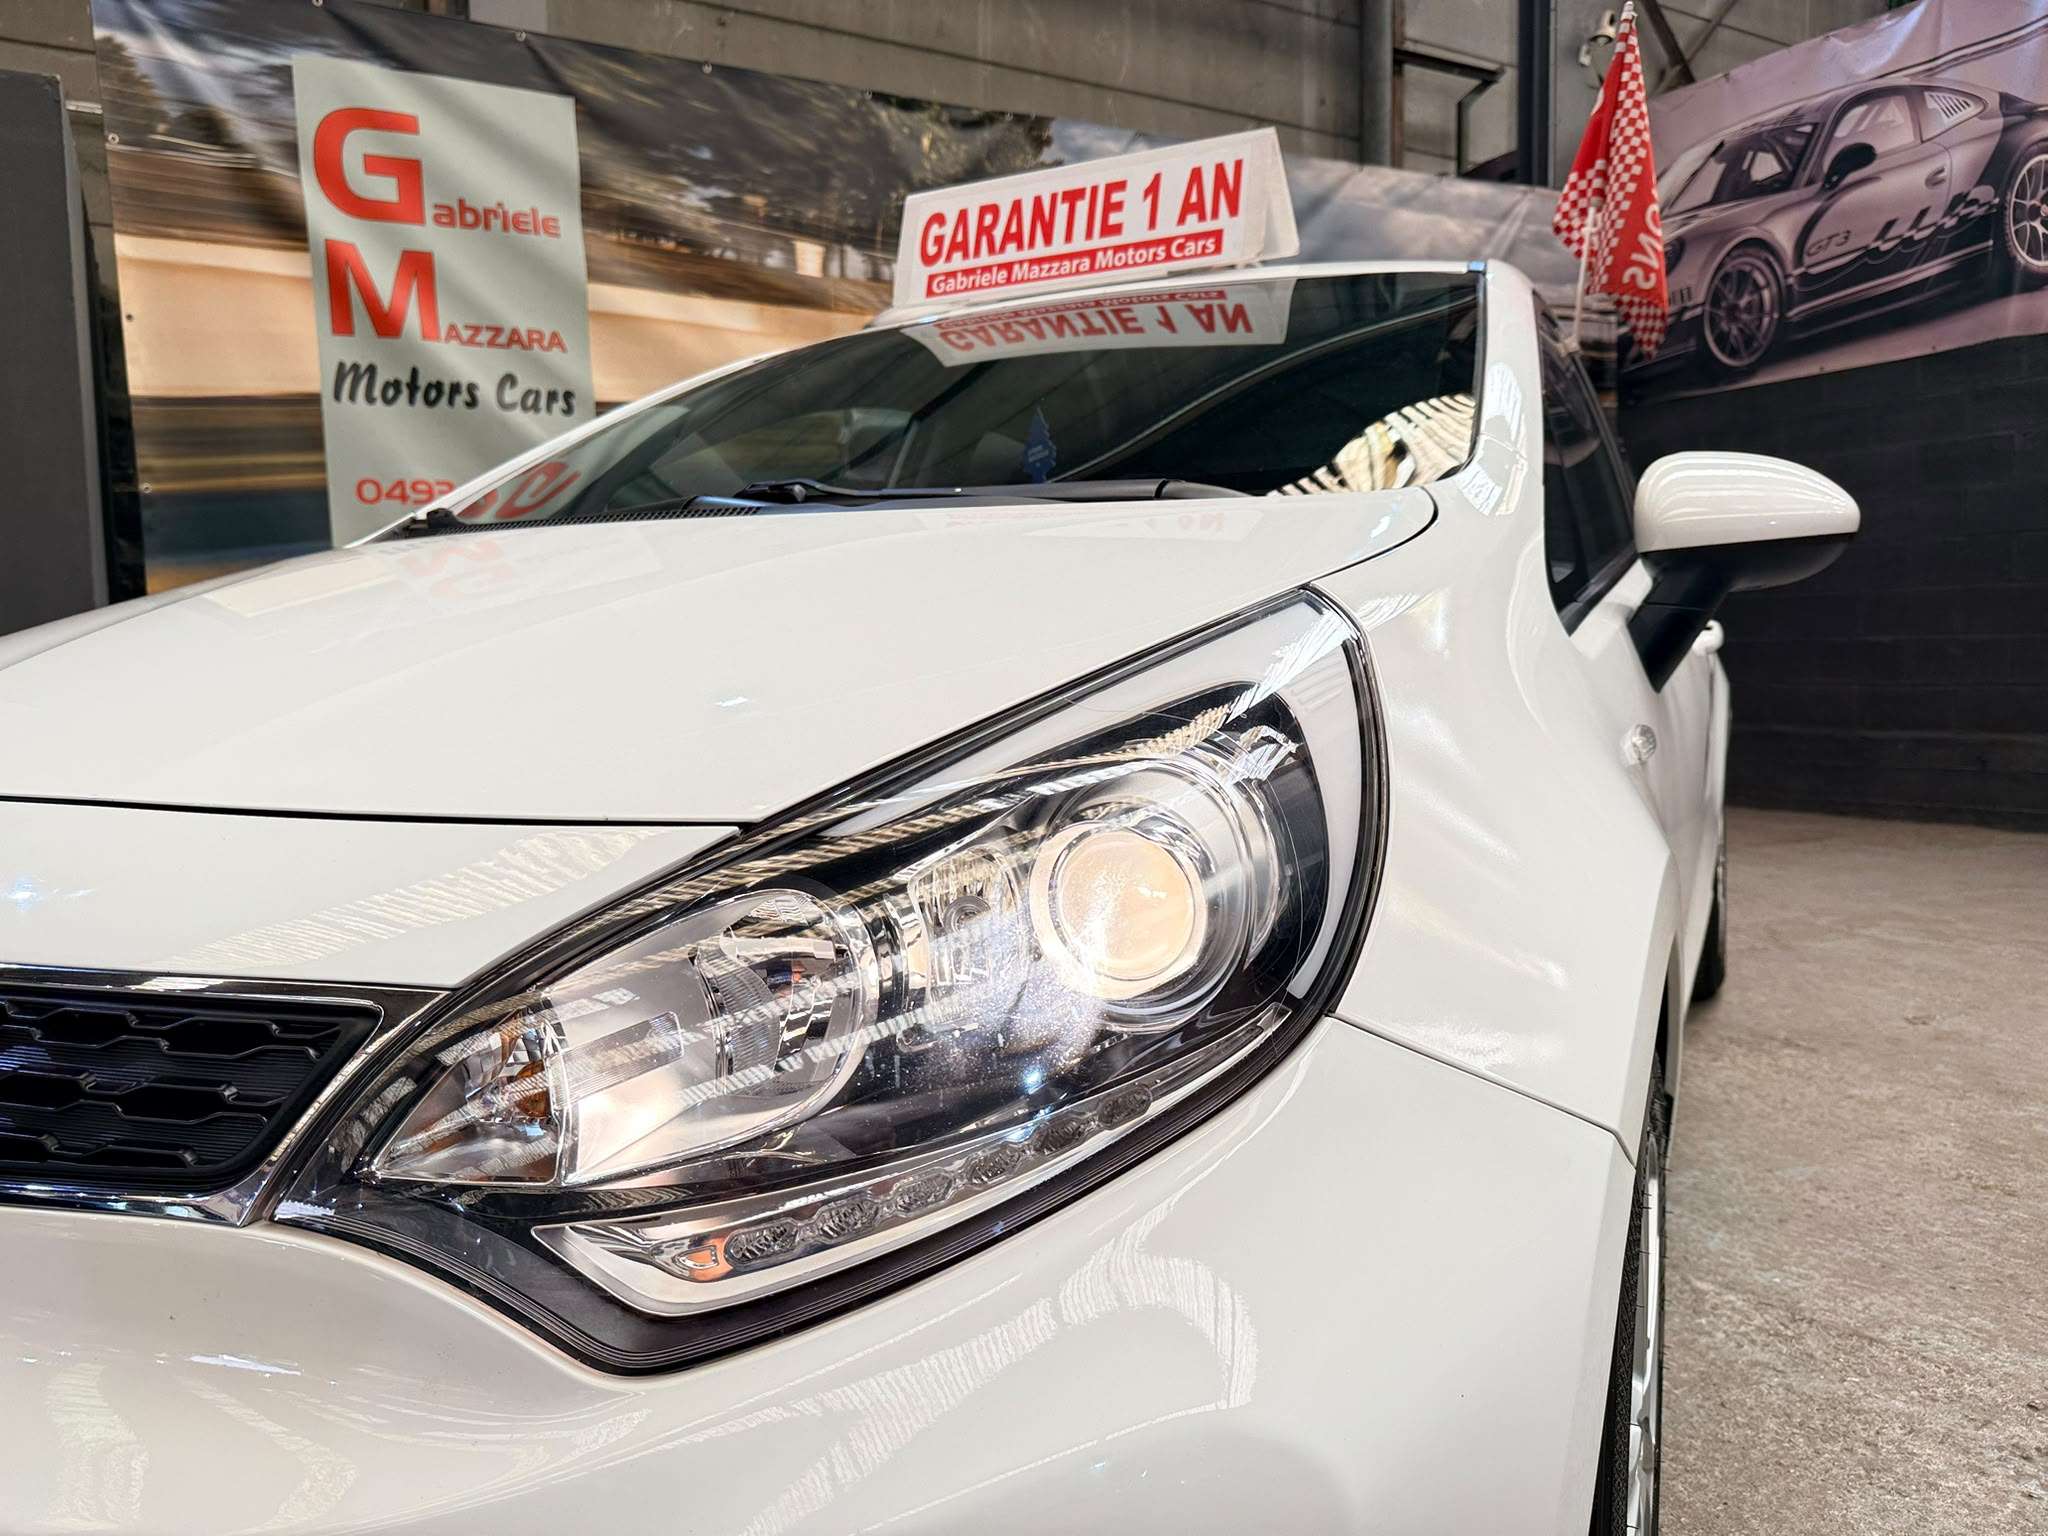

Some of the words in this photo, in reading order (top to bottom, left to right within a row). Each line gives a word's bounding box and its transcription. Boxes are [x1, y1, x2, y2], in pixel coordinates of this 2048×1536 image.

[920, 180, 1128, 268] GARANTIE
[1142, 172, 1162, 231] 1
[1177, 158, 1244, 227] AN
[931, 266, 1008, 294] Gabriele
[1011, 256, 1091, 281] Mazzara
[1095, 245, 1167, 270] Motors
[1170, 238, 1217, 258] Cars
[333, 360, 480, 409] Motors
[496, 373, 576, 416] Cars
